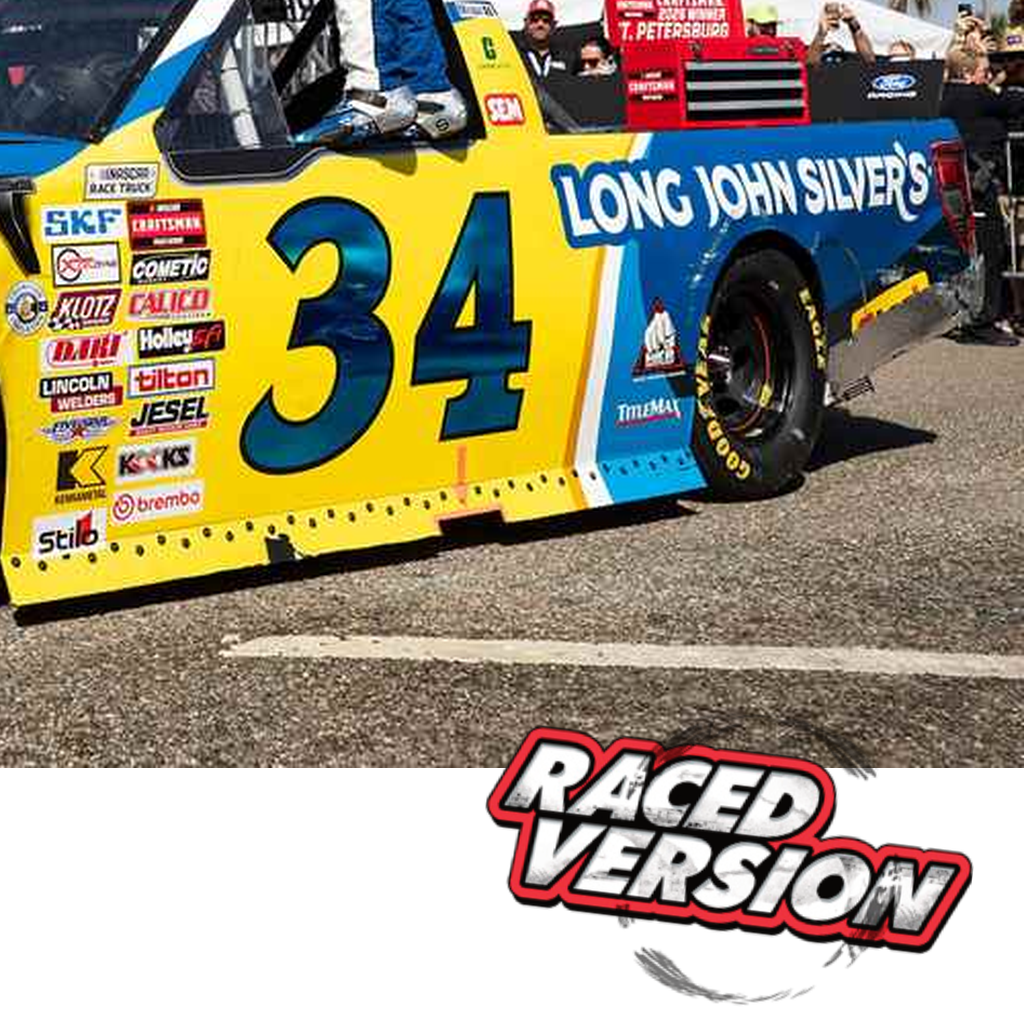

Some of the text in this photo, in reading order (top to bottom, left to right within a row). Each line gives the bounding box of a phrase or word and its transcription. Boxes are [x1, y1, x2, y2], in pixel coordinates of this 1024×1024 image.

[636, 21, 730, 41] PETERSBURG
[559, 166, 694, 237] LONG
[694, 160, 798, 228] JOHN
[44, 208, 122, 237] SKF
[132, 253, 209, 278] COMETIC
[58, 293, 116, 319] KLOTZ
[128, 288, 211, 315] CALICO
[139, 328, 193, 353] Holley
[239, 190, 533, 476] 34
[42, 374, 110, 396] LINCOLN
[134, 367, 209, 392] tilton
[56, 392, 116, 411] WELDERS
[131, 396, 209, 428] JESEL
[137, 490, 200, 513] brembo
